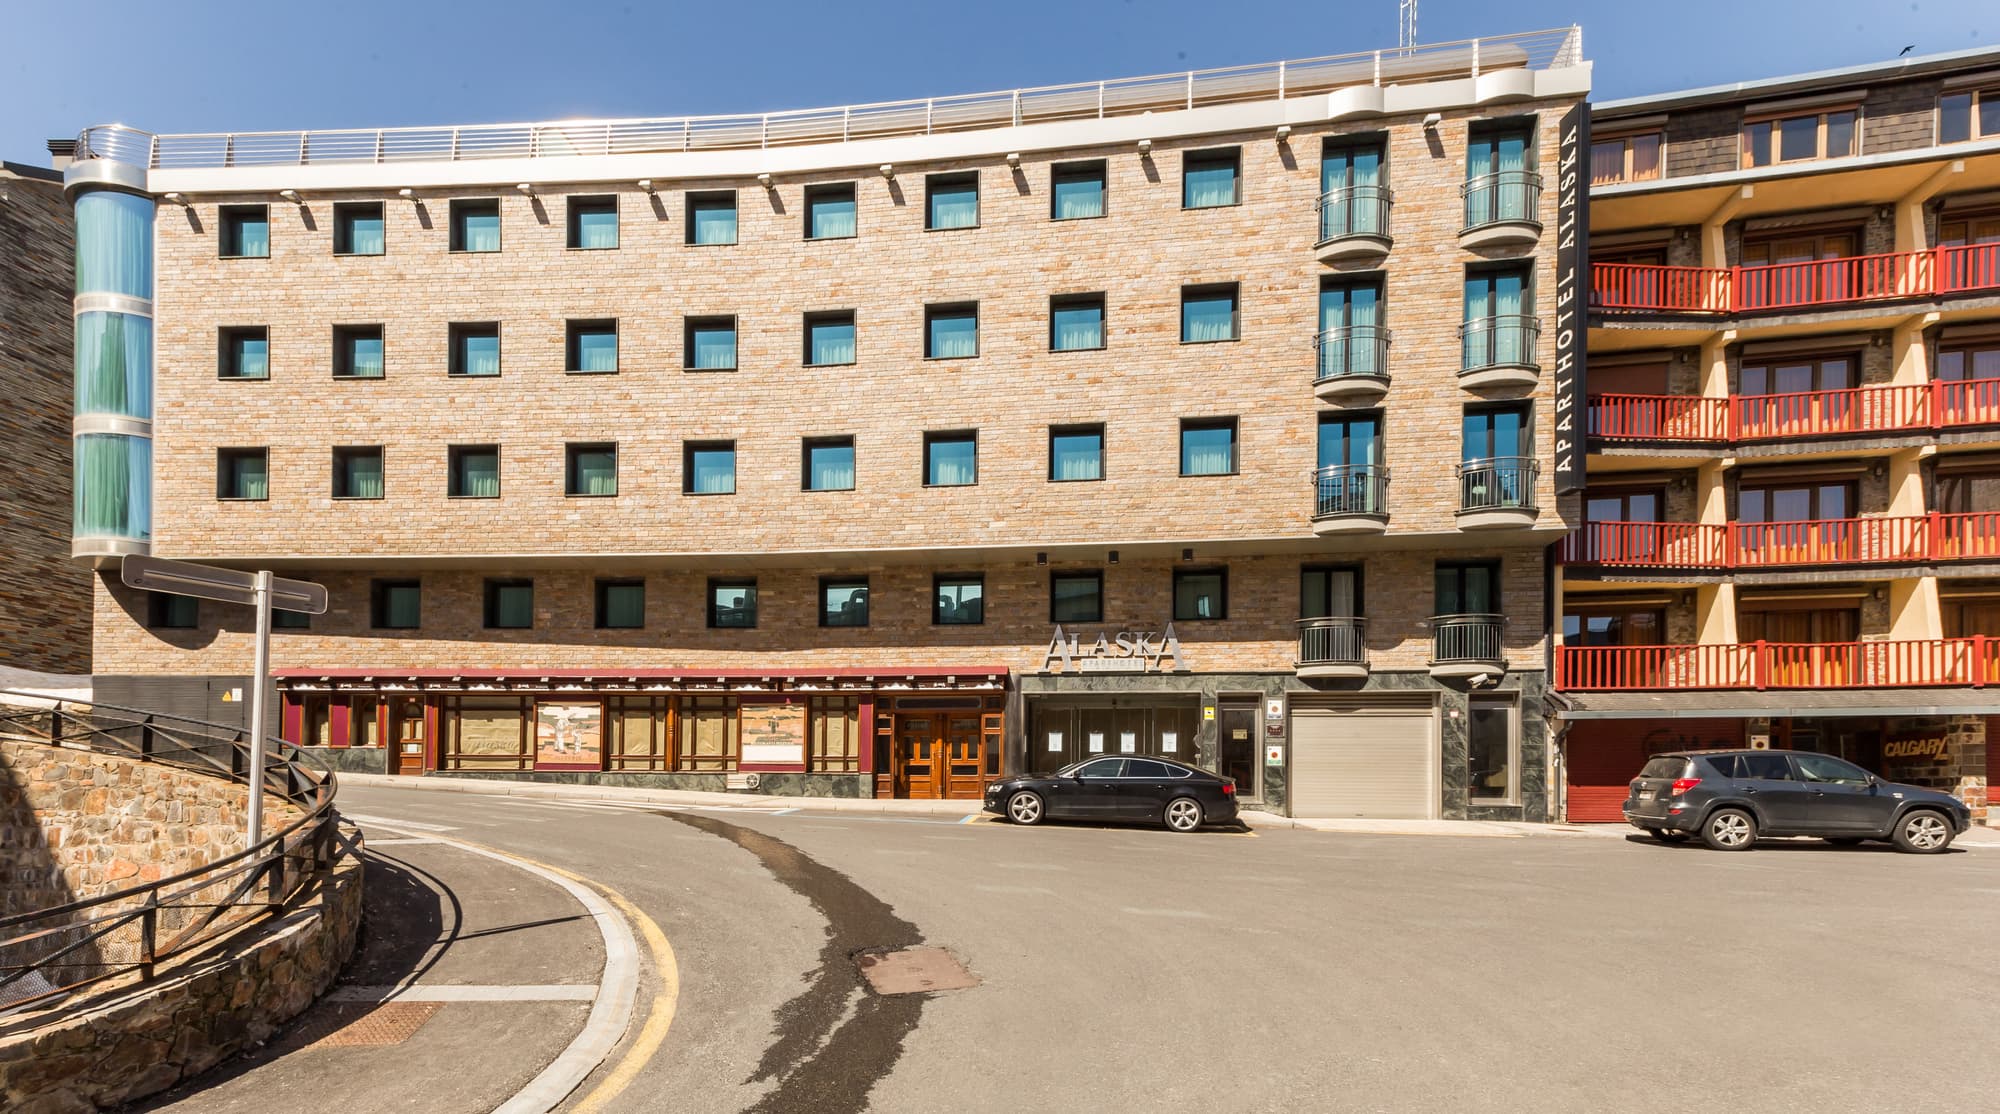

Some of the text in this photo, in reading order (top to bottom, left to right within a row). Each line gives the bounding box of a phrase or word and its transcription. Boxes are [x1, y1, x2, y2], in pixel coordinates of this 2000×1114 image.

[1556, 124, 1576, 472] APARTHOTEL ALASKA
[1039, 621, 1190, 673] ALASKA
[1884, 736, 1948, 760] CALGARY
